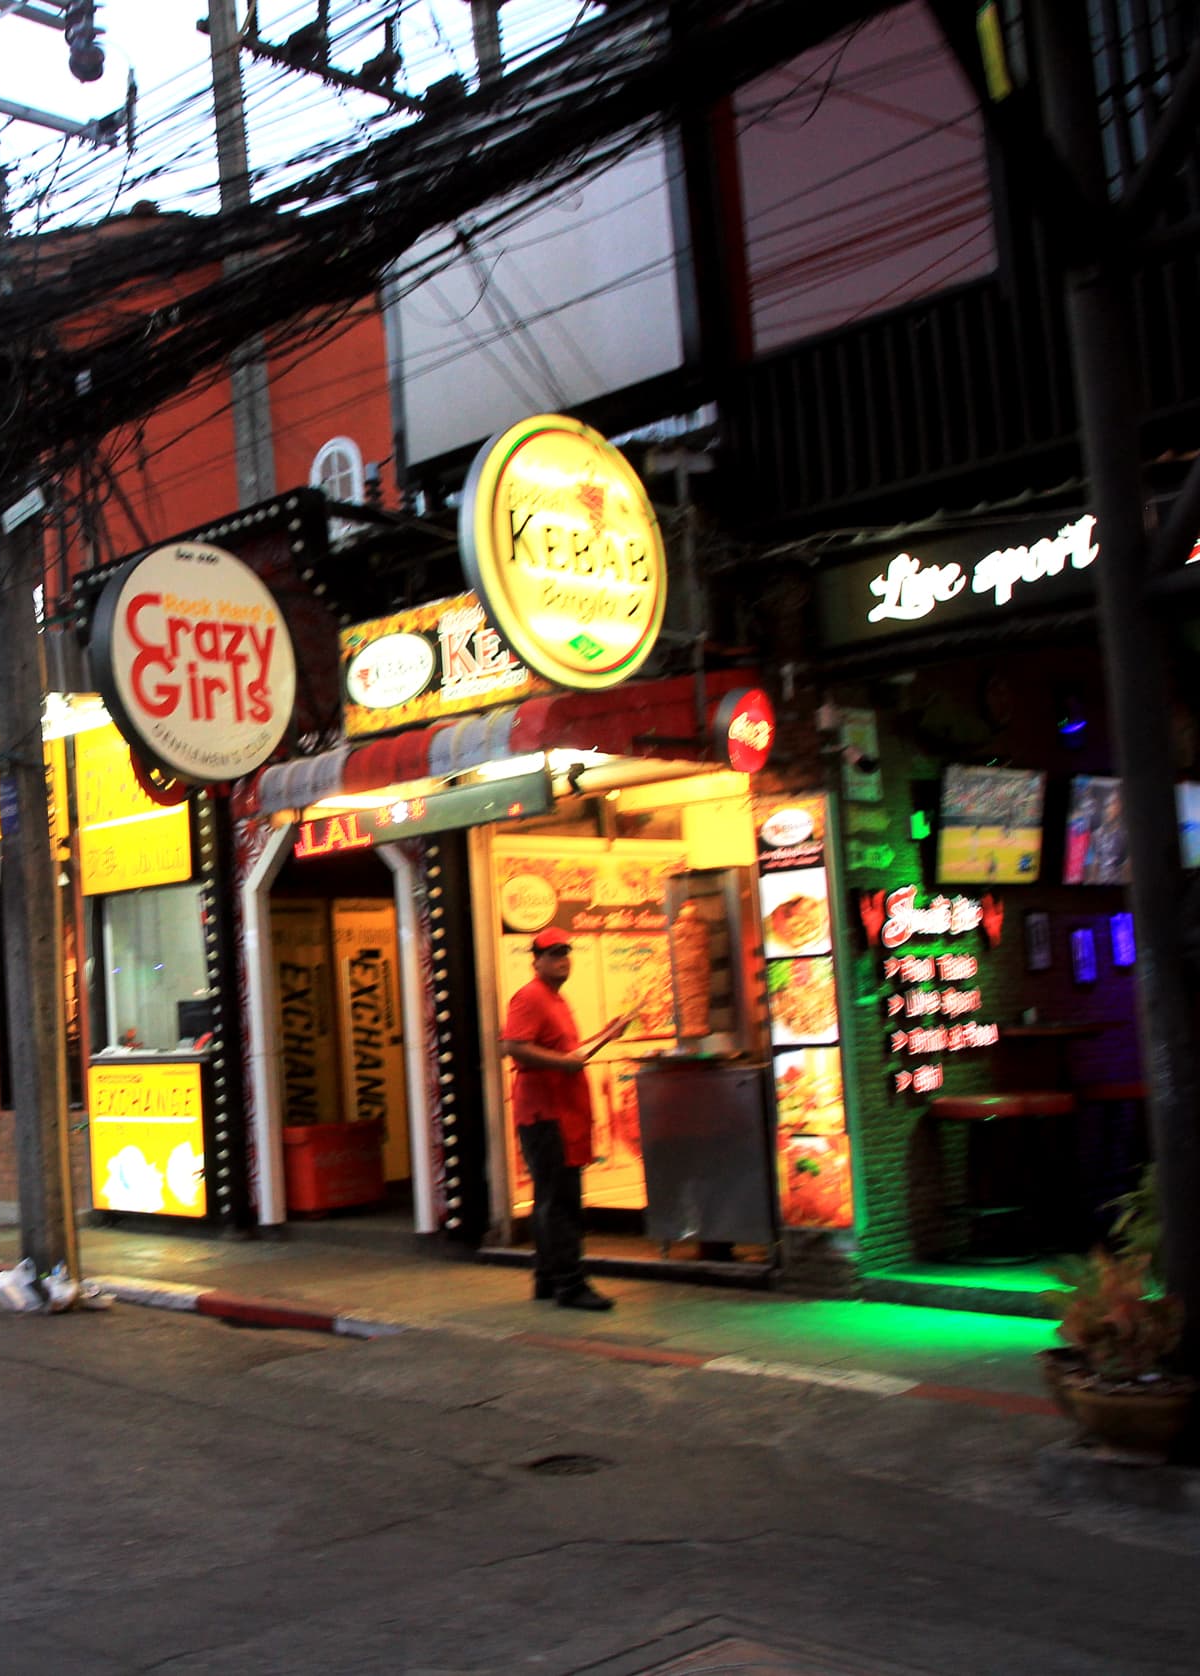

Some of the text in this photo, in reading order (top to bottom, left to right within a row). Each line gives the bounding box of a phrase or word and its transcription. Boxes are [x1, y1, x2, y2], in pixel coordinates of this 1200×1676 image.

[506, 508, 652, 583] KEBAB
[867, 553, 966, 622] Live
[125, 591, 277, 691] Crazy
[130, 647, 274, 726] Girls
[294, 813, 374, 858] LAL
[279, 961, 320, 1127] EXCHANG
[348, 955, 388, 1127] EXCHANG
[95, 1086, 197, 1118] EXCHANGE
